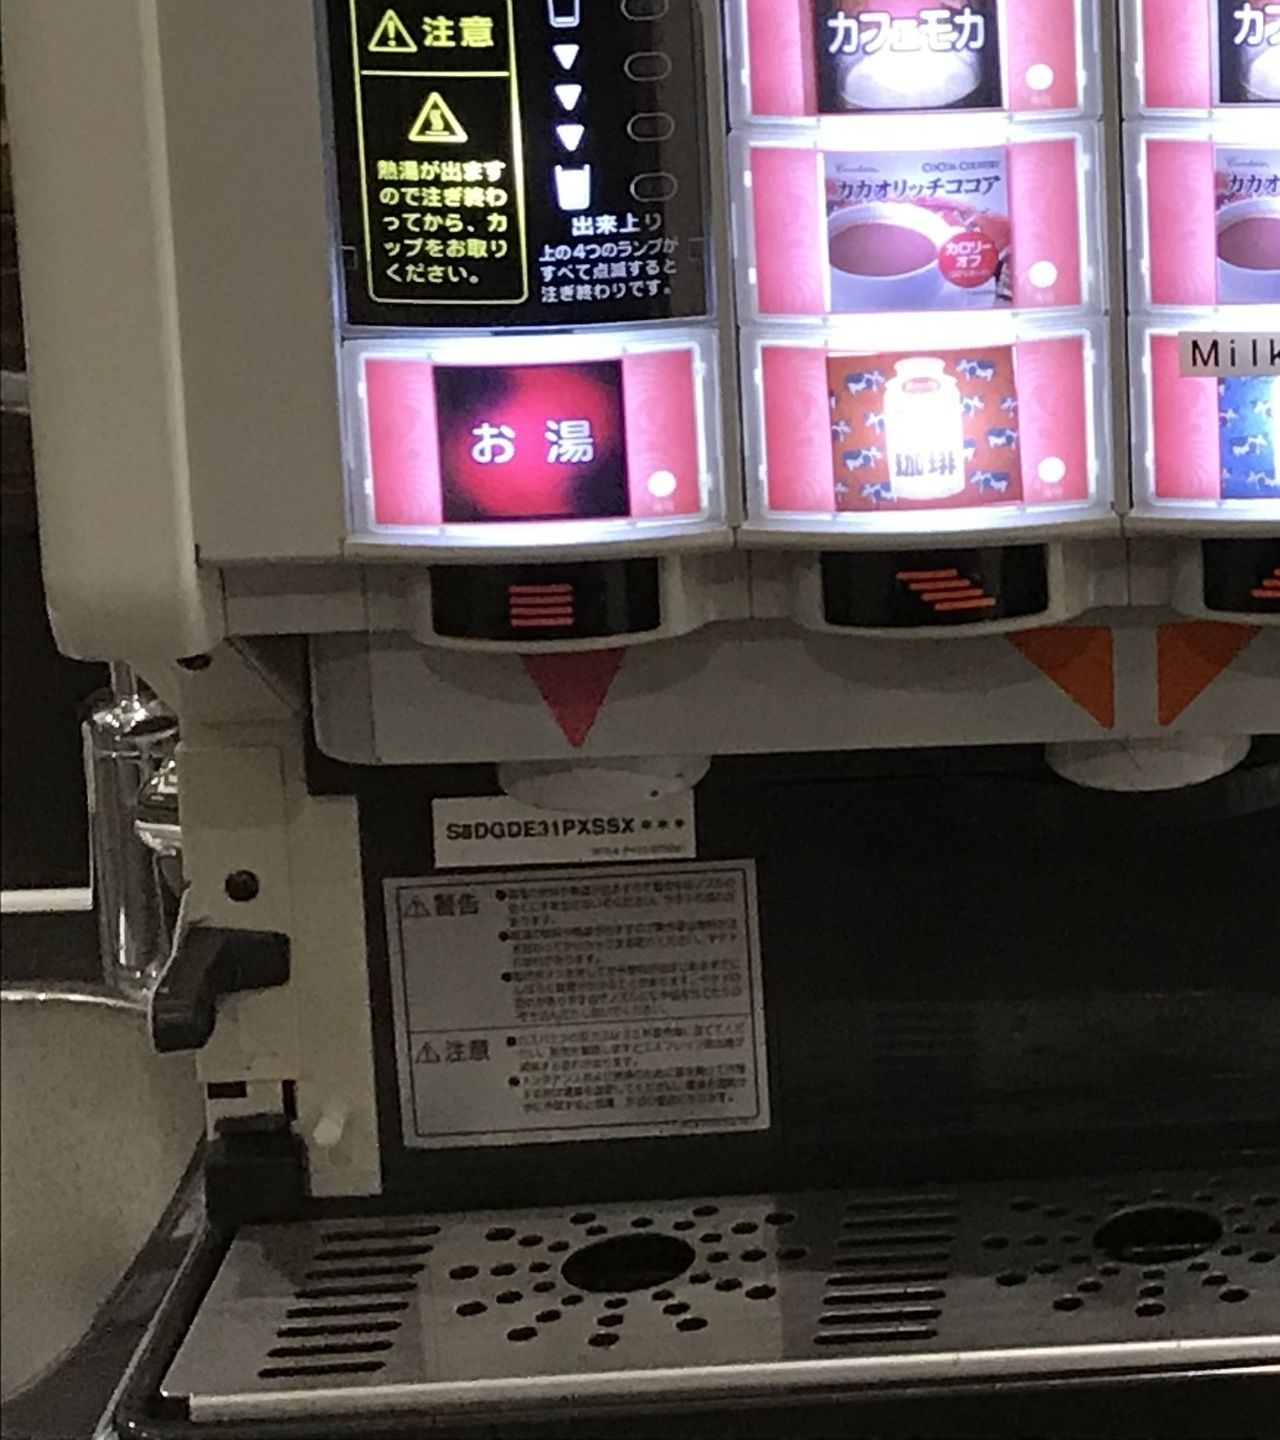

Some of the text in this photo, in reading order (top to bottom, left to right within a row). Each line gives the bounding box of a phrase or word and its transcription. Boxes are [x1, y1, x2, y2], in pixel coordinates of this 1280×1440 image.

[422, 15, 495, 48] 注意
[827, 7, 987, 54] カフェモカ
[377, 160, 506, 182] 熱湯が出ます
[379, 187, 508, 207] ので注ぎ終わ
[838, 175, 1001, 199] カカオリッチココア
[382, 212, 508, 232] ってから、カ
[571, 212, 662, 237] 出来上り
[383, 237, 508, 258] ップをお取り
[539, 237, 678, 262] 上の4つのランプが
[946, 241, 991, 256] カロリー
[540, 260, 677, 281] すべて点滅すると
[956, 256, 982, 268] オフ
[386, 263, 480, 284] ください。
[541, 281, 672, 303] 注ぎ終わりです。
[434, 894, 479, 916] 警告
[445, 1039, 490, 1061] 注意
